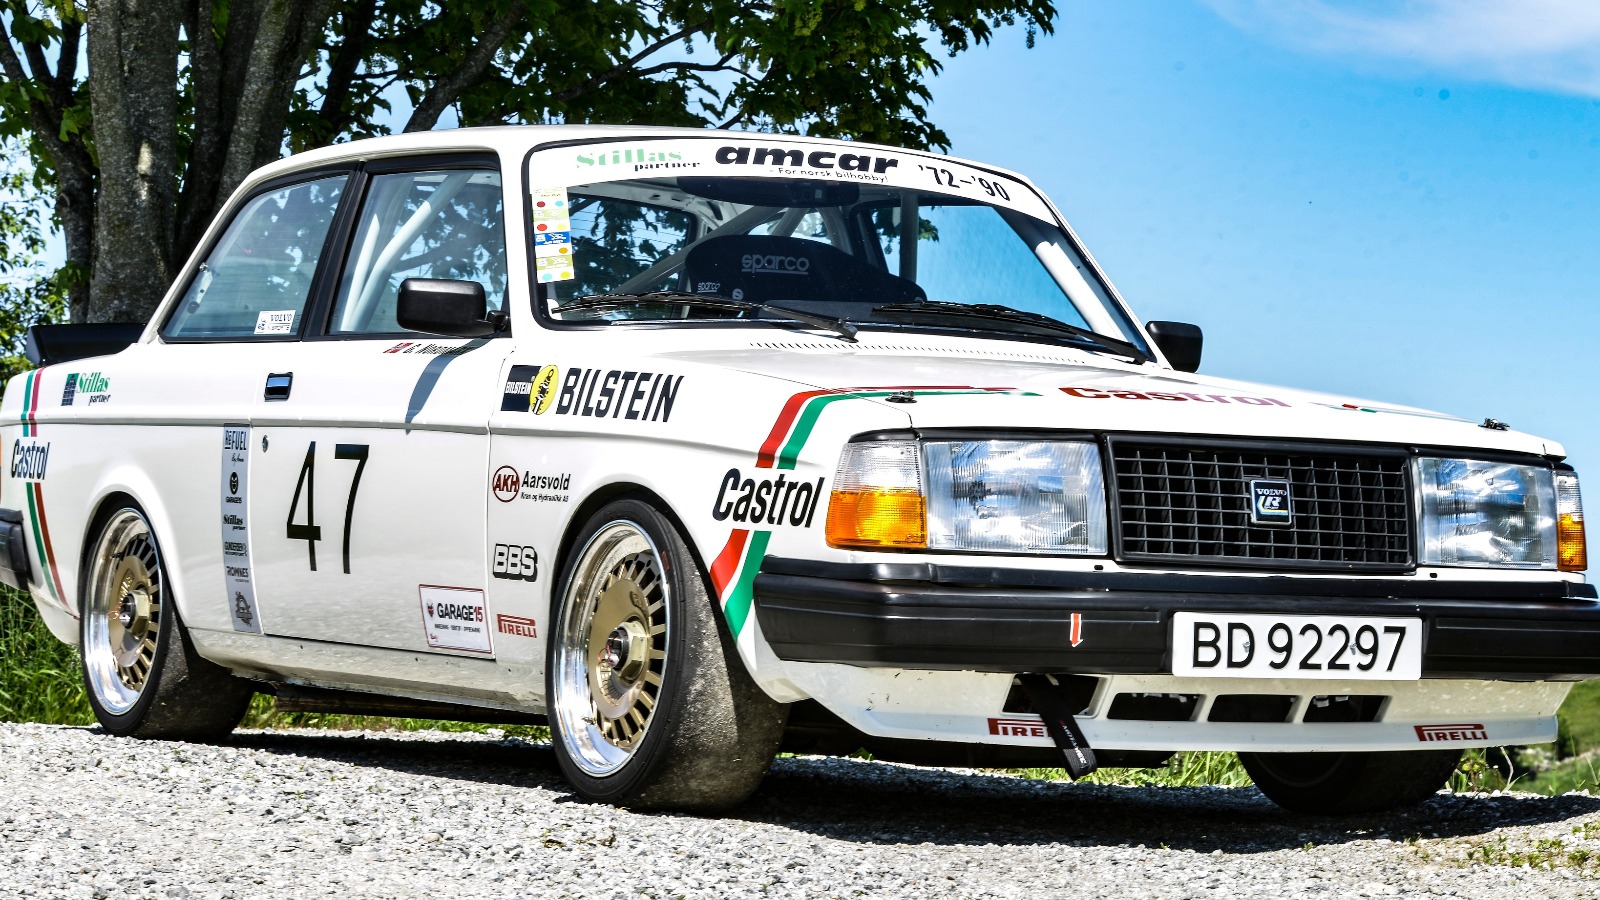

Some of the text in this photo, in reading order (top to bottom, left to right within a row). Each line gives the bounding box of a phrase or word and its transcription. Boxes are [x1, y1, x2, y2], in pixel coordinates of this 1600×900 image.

[576, 149, 682, 168] Stillas
[634, 162, 700, 172] partner
[715, 146, 899, 174] amcar
[778, 167, 796, 175] For
[835, 171, 889, 183] bilhobby!
[741, 254, 810, 275] sparco
[697, 281, 721, 293] sparco
[75, 371, 111, 394] Stillas
[504, 381, 533, 395] BILSTEIN
[87, 394, 111, 406] partner
[555, 367, 685, 423] BILSTEIN
[1058, 387, 1293, 408] Castrol
[11, 438, 51, 481] Castrol
[493, 473, 520, 493] AKH
[521, 470, 571, 491] Aarsvold
[712, 467, 826, 529] Castrol
[1255, 488, 1288, 496] VOLVO
[286, 440, 370, 575] 47
[223, 513, 244, 526] Stillas
[492, 543, 539, 582] BBS
[436, 602, 484, 623] GARAGE15
[496, 613, 538, 639] PIRELLI
[1192, 621, 1407, 672] BD 92297
[1413, 723, 1489, 742] PIRELLI
